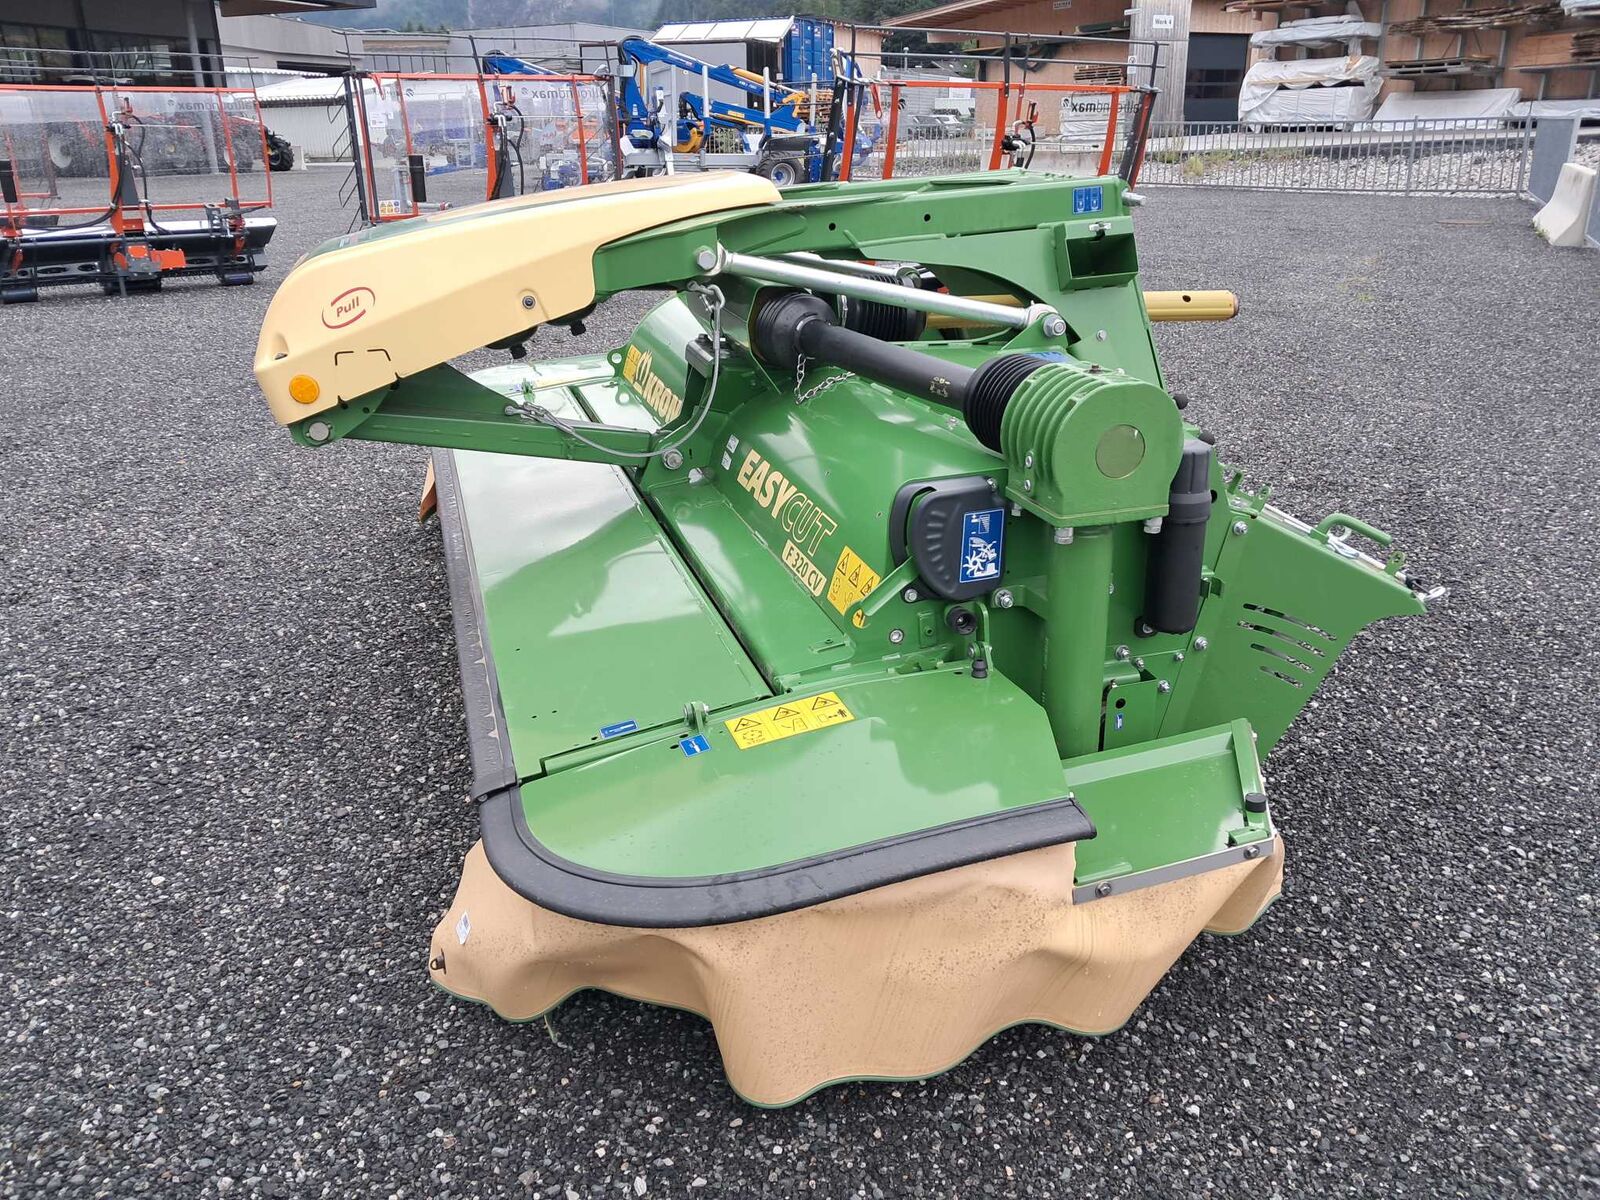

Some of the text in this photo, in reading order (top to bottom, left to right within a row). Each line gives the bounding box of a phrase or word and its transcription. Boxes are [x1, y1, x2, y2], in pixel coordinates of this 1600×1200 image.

[336, 295, 360, 318] Pull
[642, 371, 684, 423] KRON
[786, 545, 824, 593] F 320 CV
